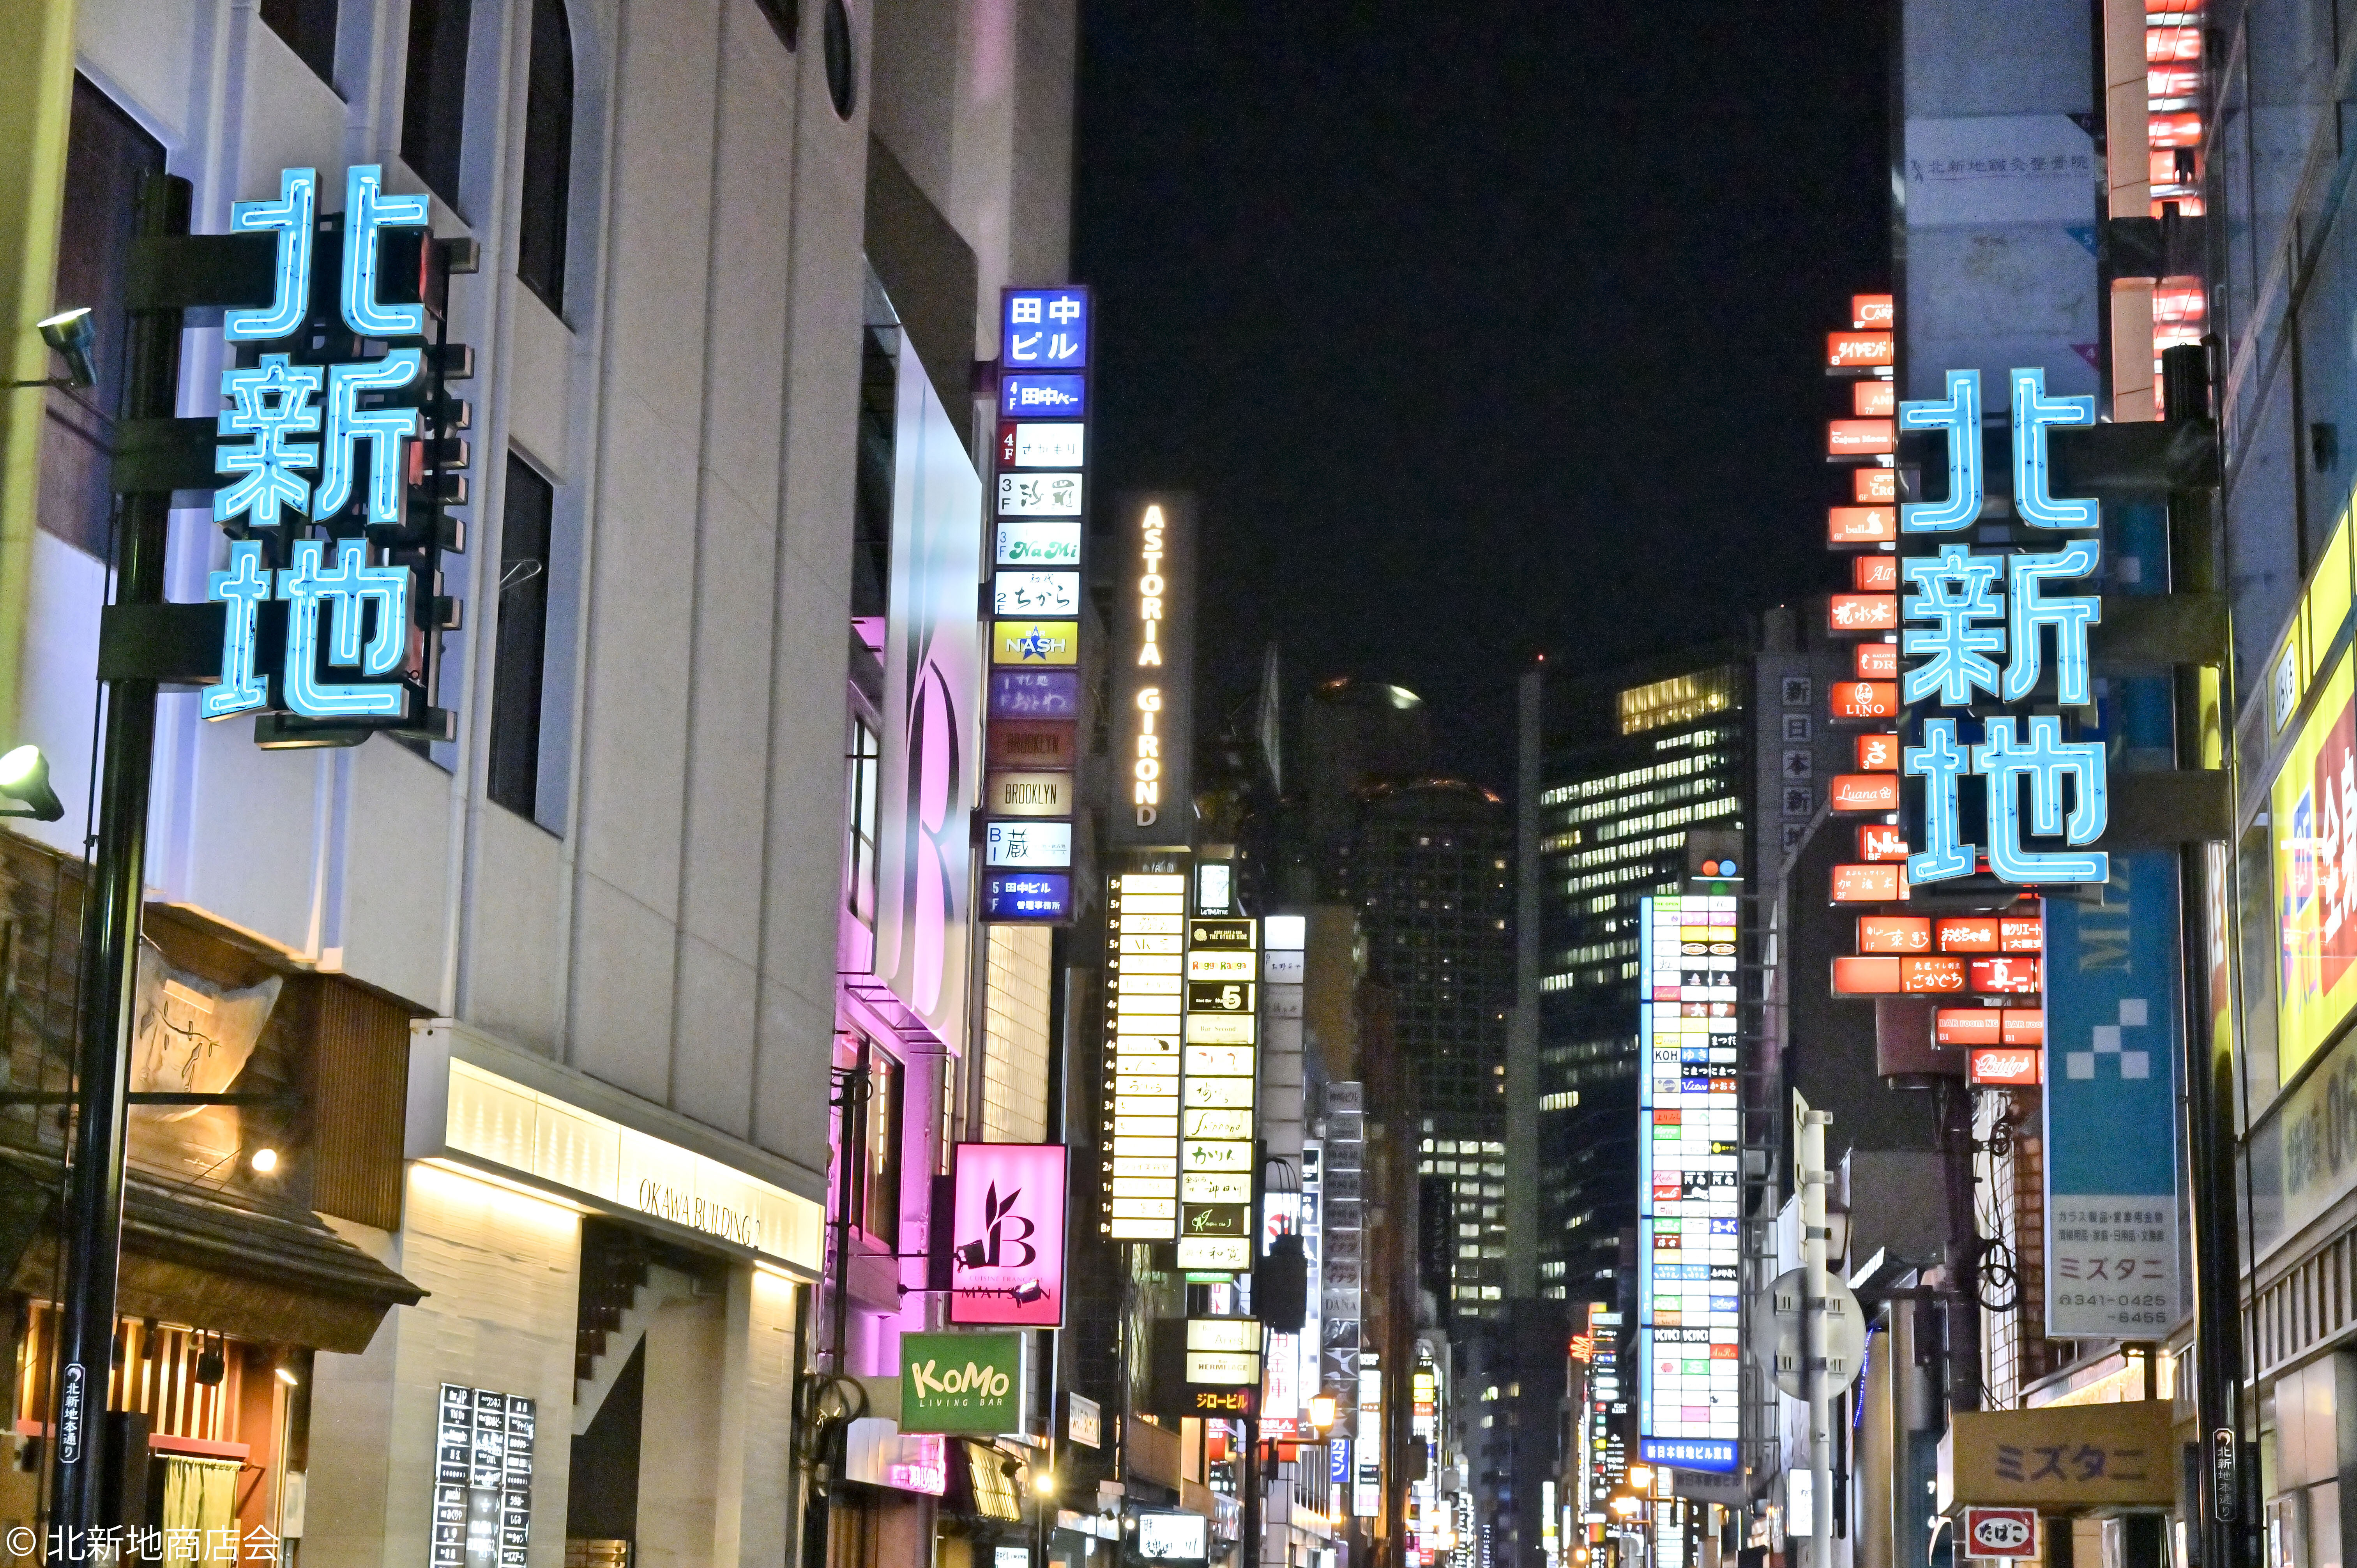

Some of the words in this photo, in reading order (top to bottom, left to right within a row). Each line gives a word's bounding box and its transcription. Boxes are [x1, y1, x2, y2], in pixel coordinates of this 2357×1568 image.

[1012, 297, 1080, 324] 田中
[1013, 332, 1077, 360] ビル
[1839, 341, 1886, 357] ダイヤモンド
[1022, 388, 1078, 405] 田中バー
[201, 165, 429, 720] 北新地
[1004, 433, 1013, 460] 4F
[1002, 479, 1011, 510] 3F
[1000, 531, 1007, 556] 3F
[1140, 506, 1165, 666] ASTORIA
[1015, 585, 1069, 609] ちから
[997, 593, 1006, 614] 2F
[1832, 602, 1891, 624] 花水木
[1899, 367, 2108, 884] 北新地
[1005, 638, 1066, 653] NASH
[1873, 660, 1896, 669] DR
[1846, 704, 1884, 714] LINO
[1005, 784, 1057, 804] BROOKLYN
[1836, 784, 1877, 802] Luana
[1006, 828, 1030, 858] 蔵
[1005, 883, 1051, 894] 田中ビル
[1111, 880, 1120, 889] 5F
[1110, 900, 1120, 909] 5F
[1110, 920, 1120, 929] 5F
[1110, 940, 1119, 949] 5F
[1109, 960, 1118, 969] 4F
[1221, 961, 1246, 970] Ragga
[1108, 980, 1118, 989] 4F
[1913, 973, 1962, 989] さかぐち
[1107, 1000, 1117, 1009] 4F
[1107, 1021, 1117, 1029] 4F
[1939, 1019, 1958, 1027] BAR
[1986, 1019, 1999, 1027] NG
[1106, 1040, 1116, 1049] 4F
[1712, 1036, 1736, 1045] まつだ
[1656, 1051, 1677, 1060] KOH
[1683, 1050, 1707, 1061] ゆき
[1105, 1061, 1115, 1070] 4F
[1105, 1081, 1115, 1090] 4F
[1710, 1081, 1736, 1091] かおる
[1104, 1101, 1114, 1110] 3F
[1104, 1121, 1113, 1130] 3F
[1103, 1142, 1113, 1151] 2F
[1193, 1146, 1235, 1165] かりん
[1103, 1162, 1112, 1171] 2F
[1103, 1183, 1111, 1192] 1F
[640, 1179, 689, 1227] OKAWA
[694, 1197, 750, 1245] BUILDING
[1103, 1204, 1111, 1213] 1F
[1101, 1224, 1110, 1233] BF
[2060, 1257, 2164, 1280] ミズタニ
[962, 1287, 1050, 1300] MAISN
[1326, 1299, 1357, 1311] DANA
[1654, 1329, 1680, 1341] KIKI
[1683, 1330, 1709, 1342] KIKI
[920, 1398, 968, 1407] LIVING
[980, 1398, 1002, 1406] BAR
[63, 1382, 80, 1458] 北新地本通り
[2217, 1446, 2232, 1517] 北新地本通り
[1979, 1524, 2023, 1543] たばこ
